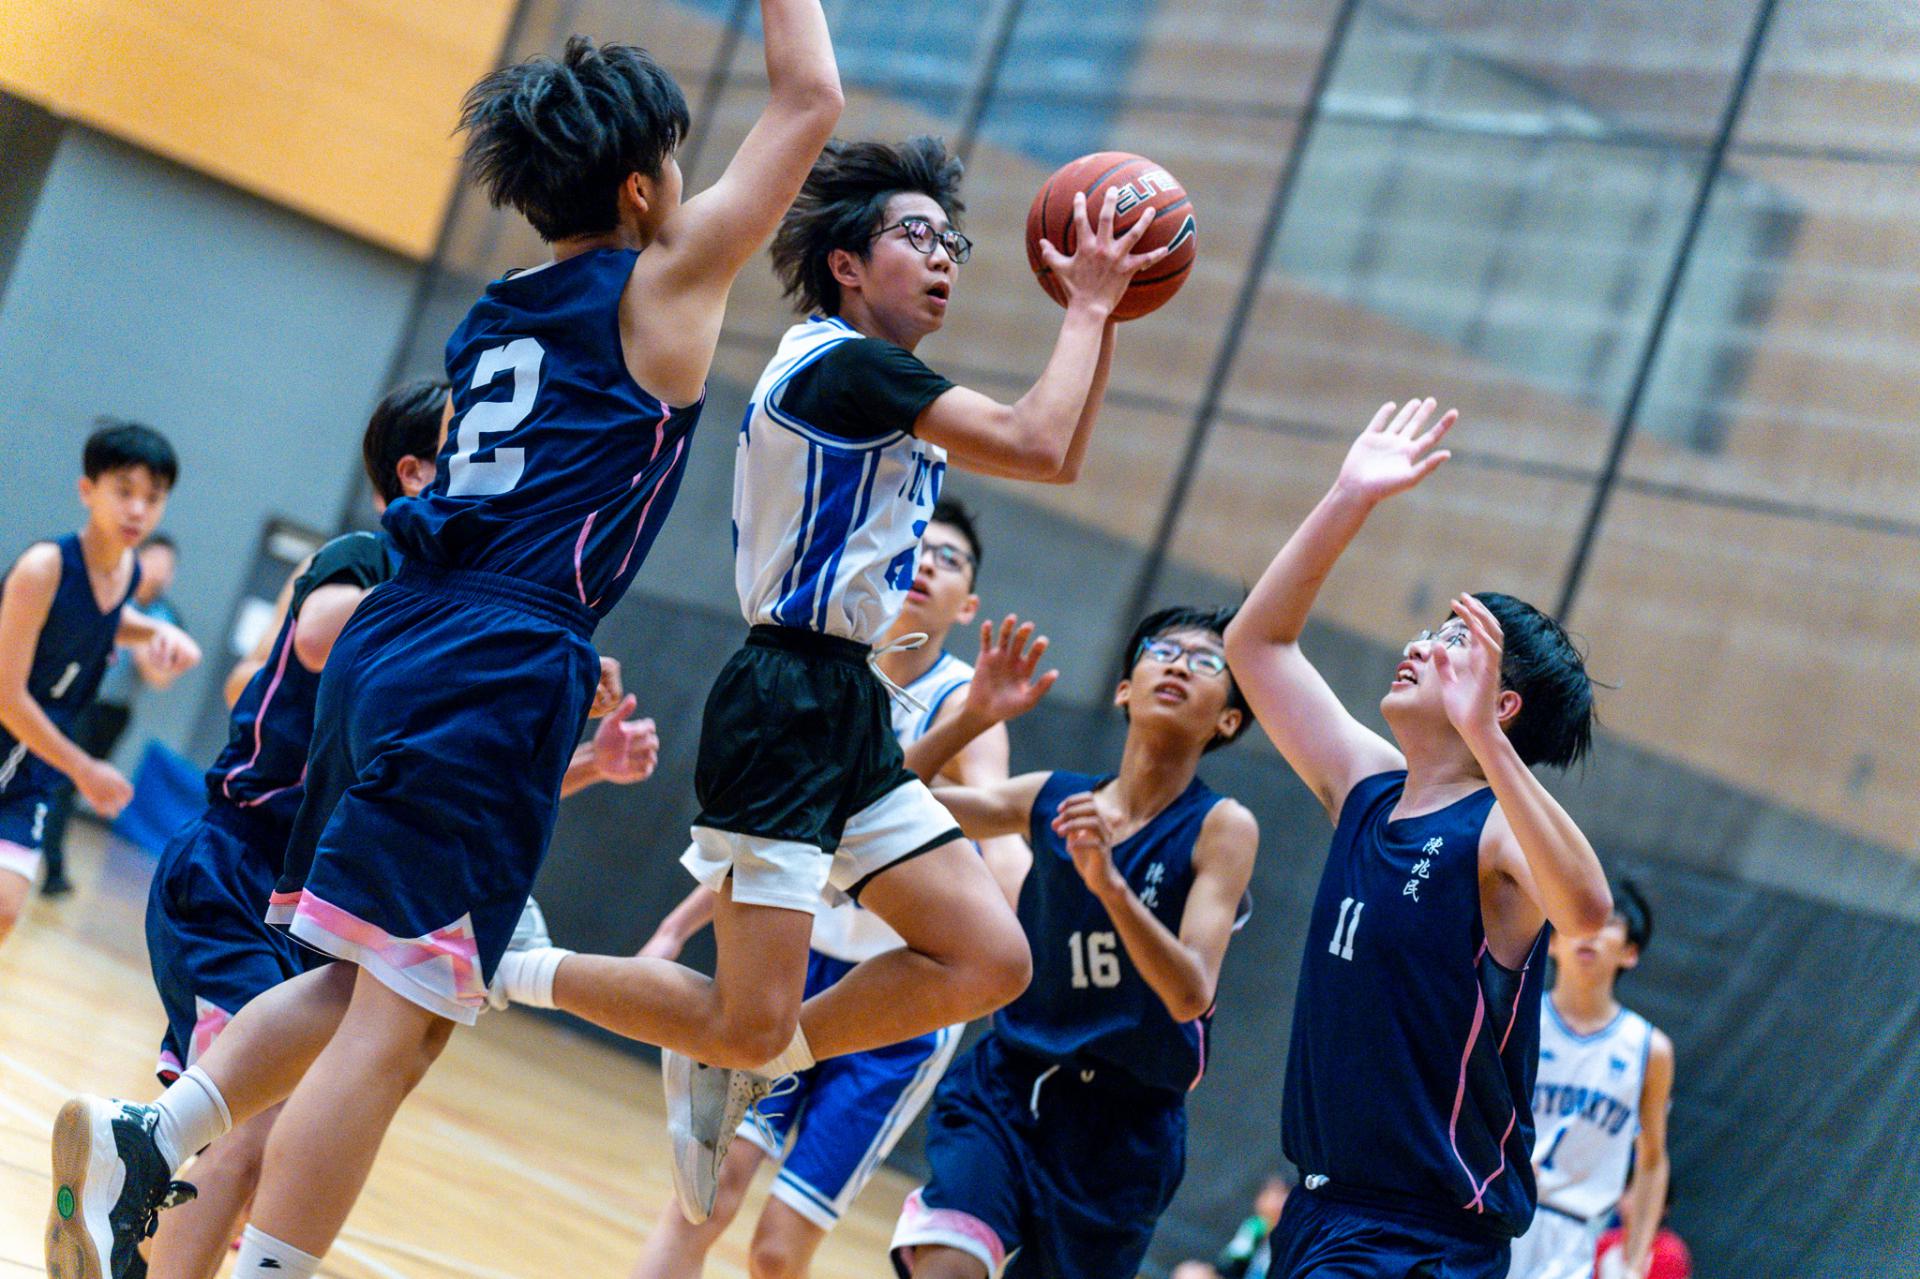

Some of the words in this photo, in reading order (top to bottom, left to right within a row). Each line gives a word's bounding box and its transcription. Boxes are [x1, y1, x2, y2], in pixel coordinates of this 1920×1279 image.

[446, 337, 546, 497] 2
[1068, 931, 1121, 988] 16
[1328, 897, 1365, 961] 11
